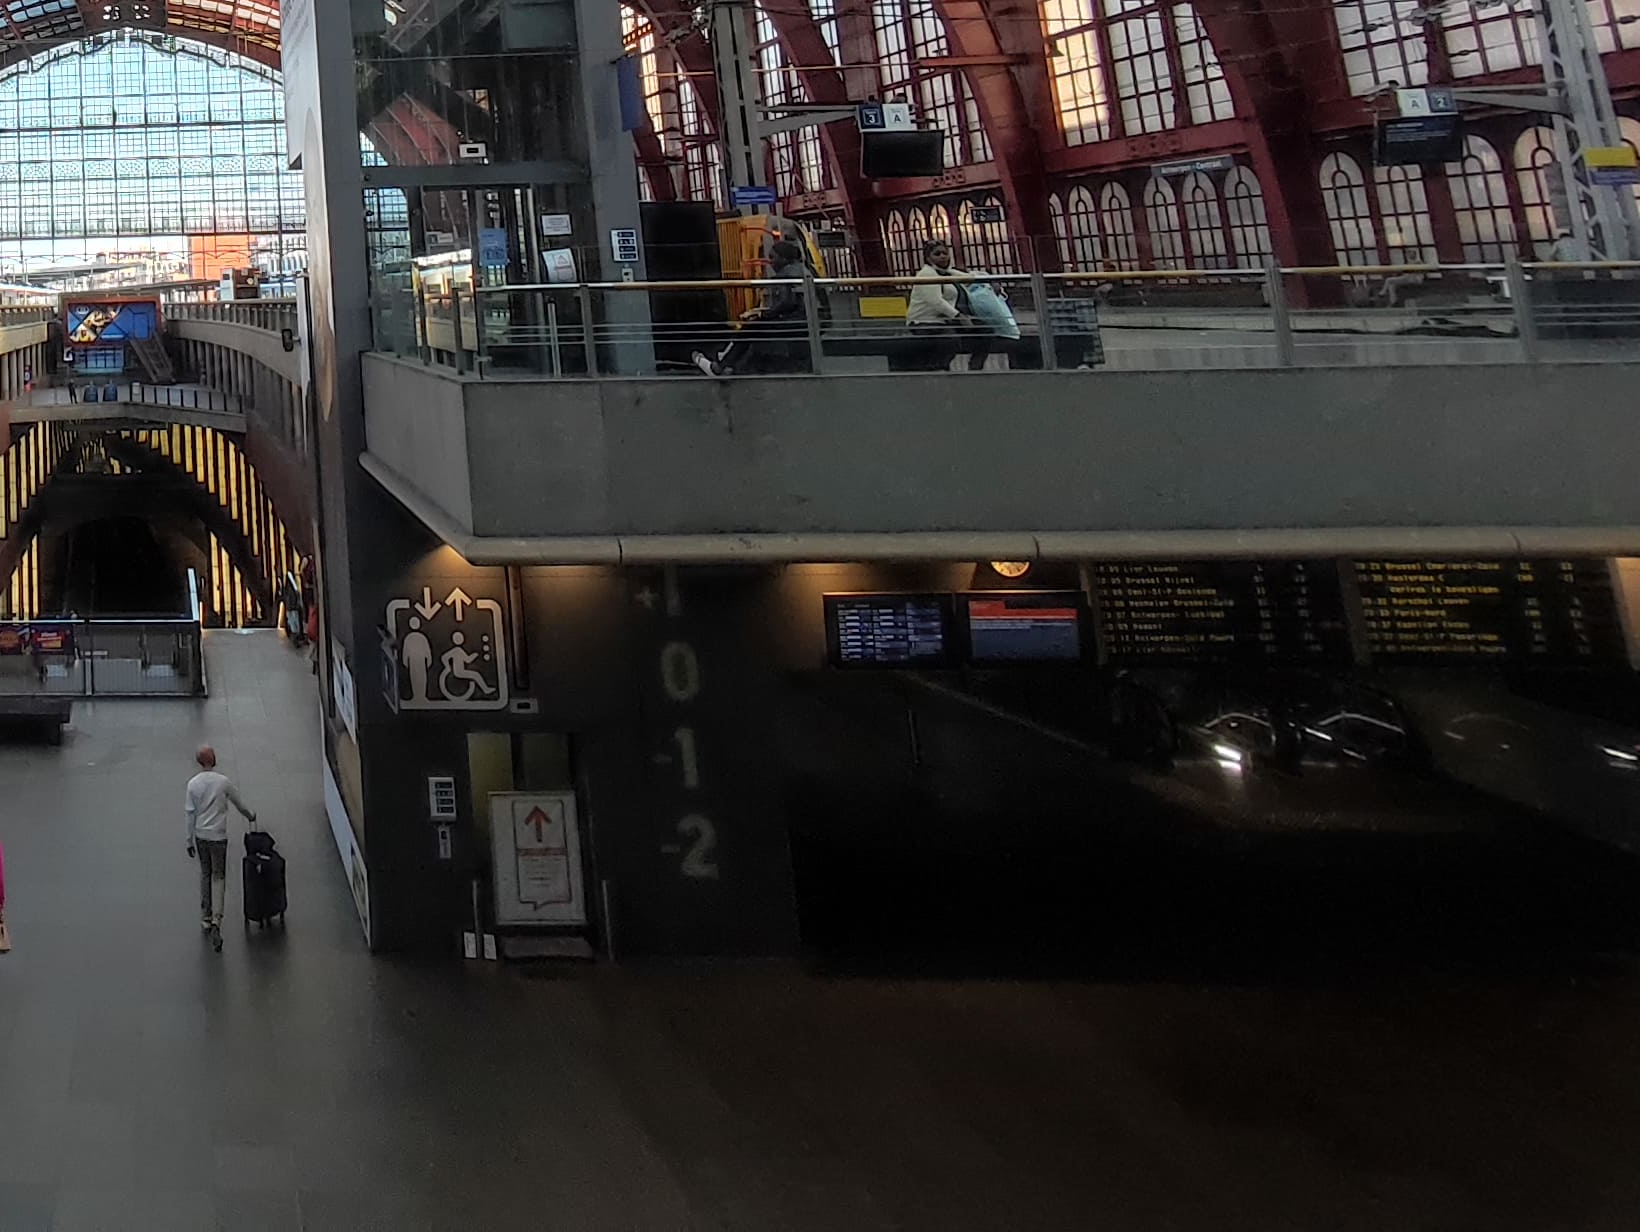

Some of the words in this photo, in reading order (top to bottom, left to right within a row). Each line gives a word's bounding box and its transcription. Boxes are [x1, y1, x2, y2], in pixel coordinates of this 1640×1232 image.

[868, 114, 877, 124] 3
[894, 113, 903, 124] A
[660, 640, 701, 702] 0
[651, 726, 701, 791] -1
[660, 813, 720, 880] -2
